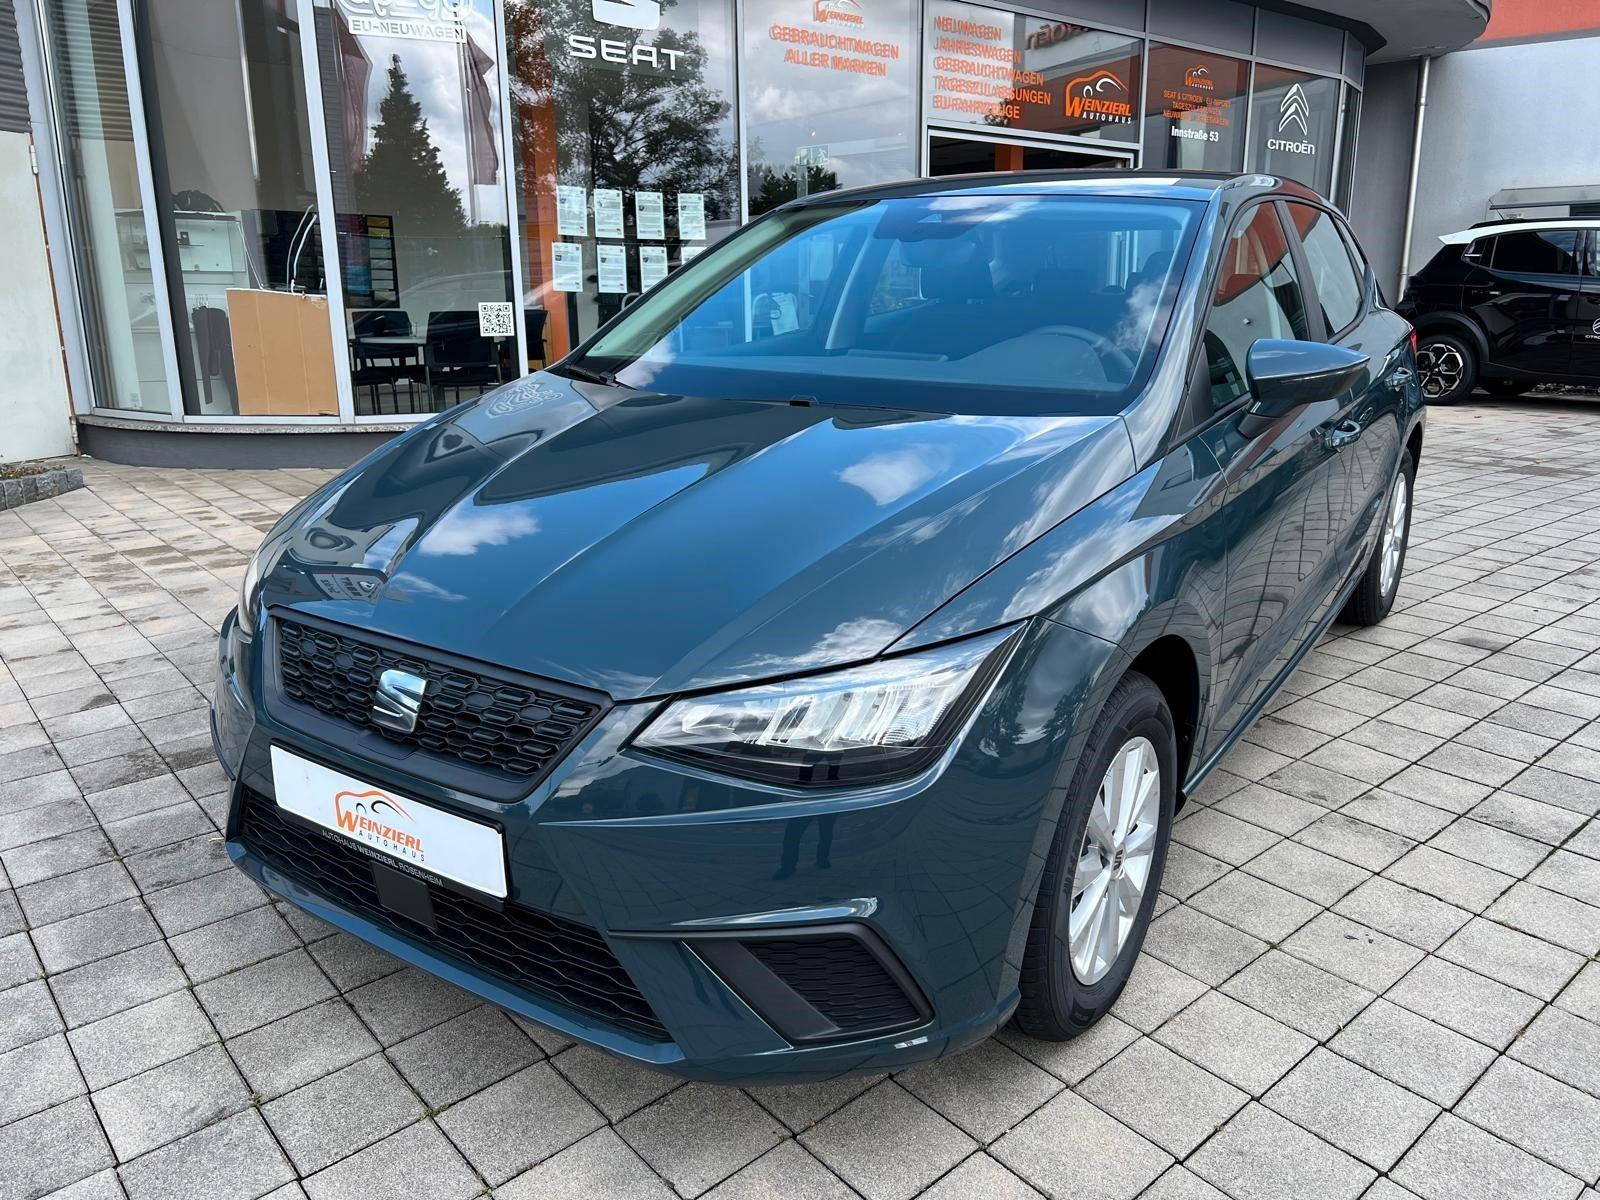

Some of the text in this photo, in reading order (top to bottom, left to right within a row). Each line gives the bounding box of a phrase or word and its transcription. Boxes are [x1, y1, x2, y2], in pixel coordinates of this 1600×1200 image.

[352, 20, 464, 39] EU-NEUWAGEN
[769, 24, 899, 60] GEBRAUCHTWAGEN
[933, 15, 1003, 41] NEUWAGEN
[568, 34, 685, 71] SEAT
[784, 48, 886, 77] ALLER MARKEN
[933, 36, 1022, 65] JAHRESWAGEN
[933, 55, 1044, 87] GEBRAUCHTWAGEN
[933, 74, 1052, 106] TAGESZULASSUNGEN
[1065, 95, 1132, 118] WEINZIERL
[1082, 111, 1132, 125] AUTOHAUS
[1171, 125, 1219, 142] Innstraße 53
[336, 810, 425, 853] WEINZIERL
[358, 829, 426, 863] AUTOHAUS
[321, 829, 445, 888] AUTOHAUS WEINZIERL ROSENHEIM
